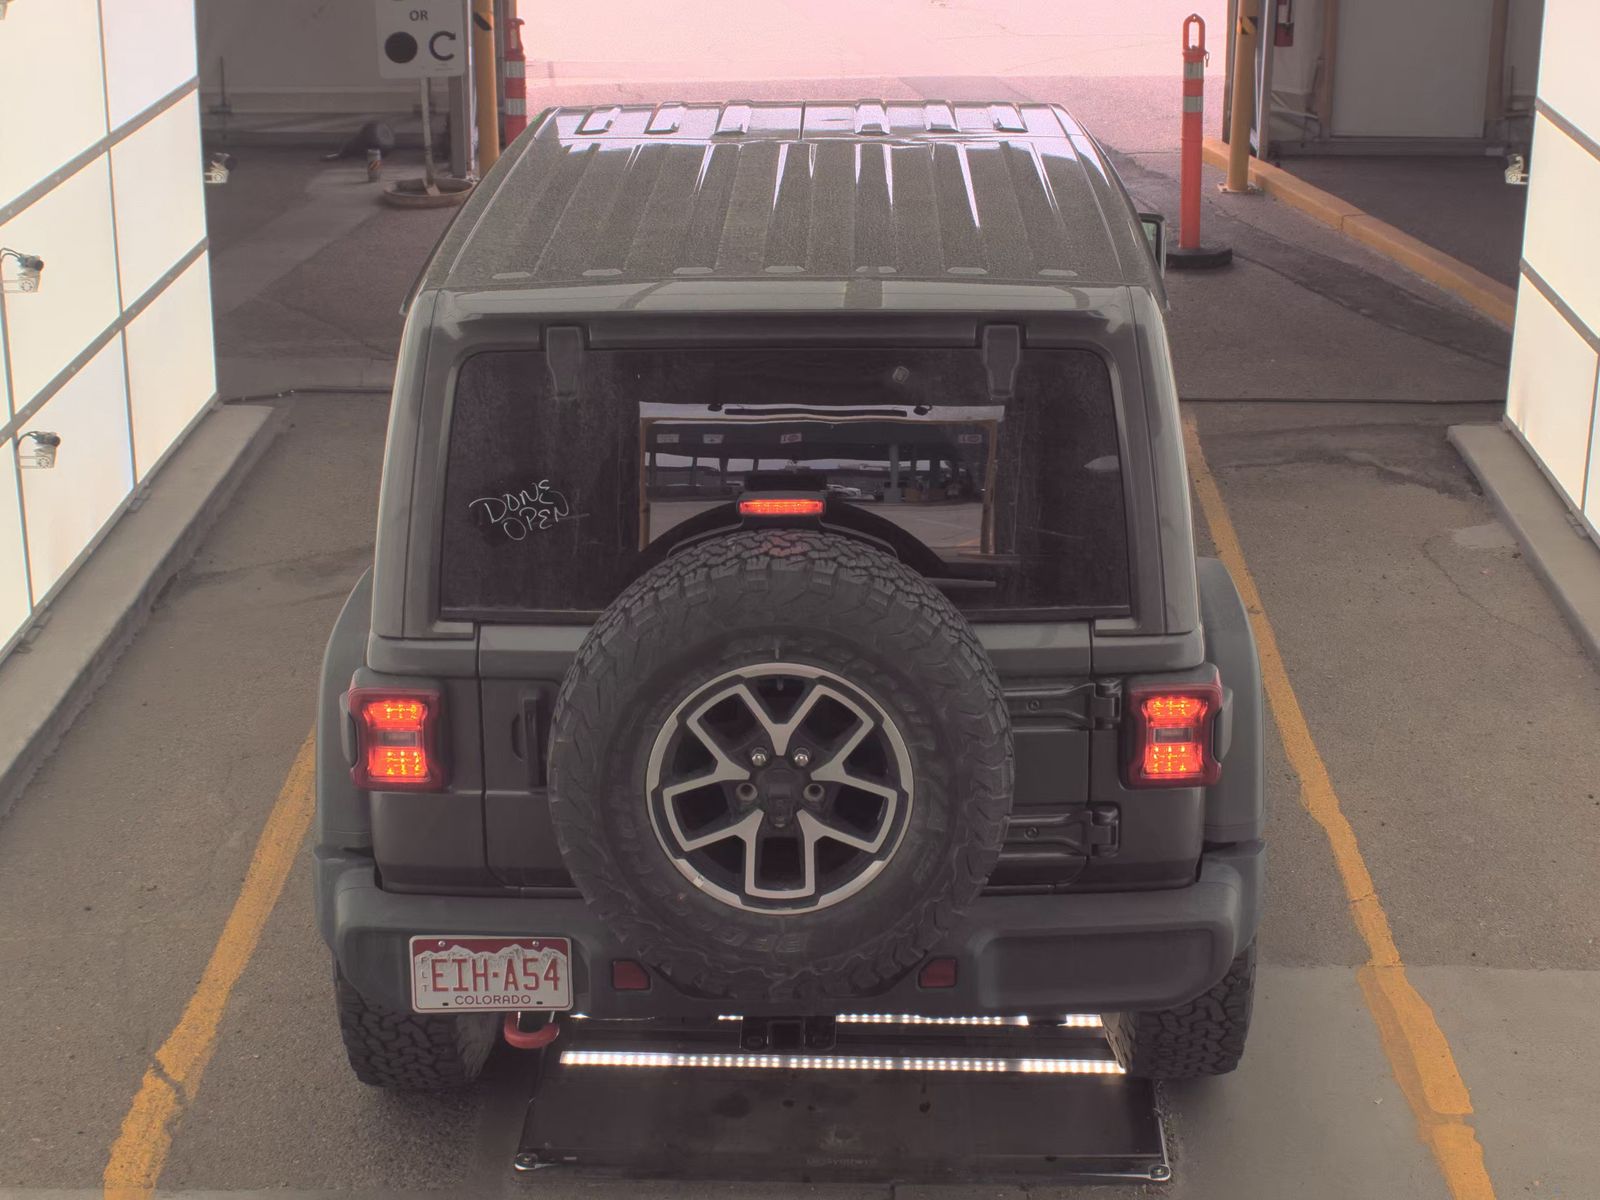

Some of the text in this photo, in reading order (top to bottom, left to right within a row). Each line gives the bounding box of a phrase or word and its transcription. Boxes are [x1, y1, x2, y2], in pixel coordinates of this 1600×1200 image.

[409, 9, 429, 21] OR
[468, 479, 554, 523] DONE
[501, 491, 570, 541] OPEN
[454, 994, 531, 1005] COLORADO
